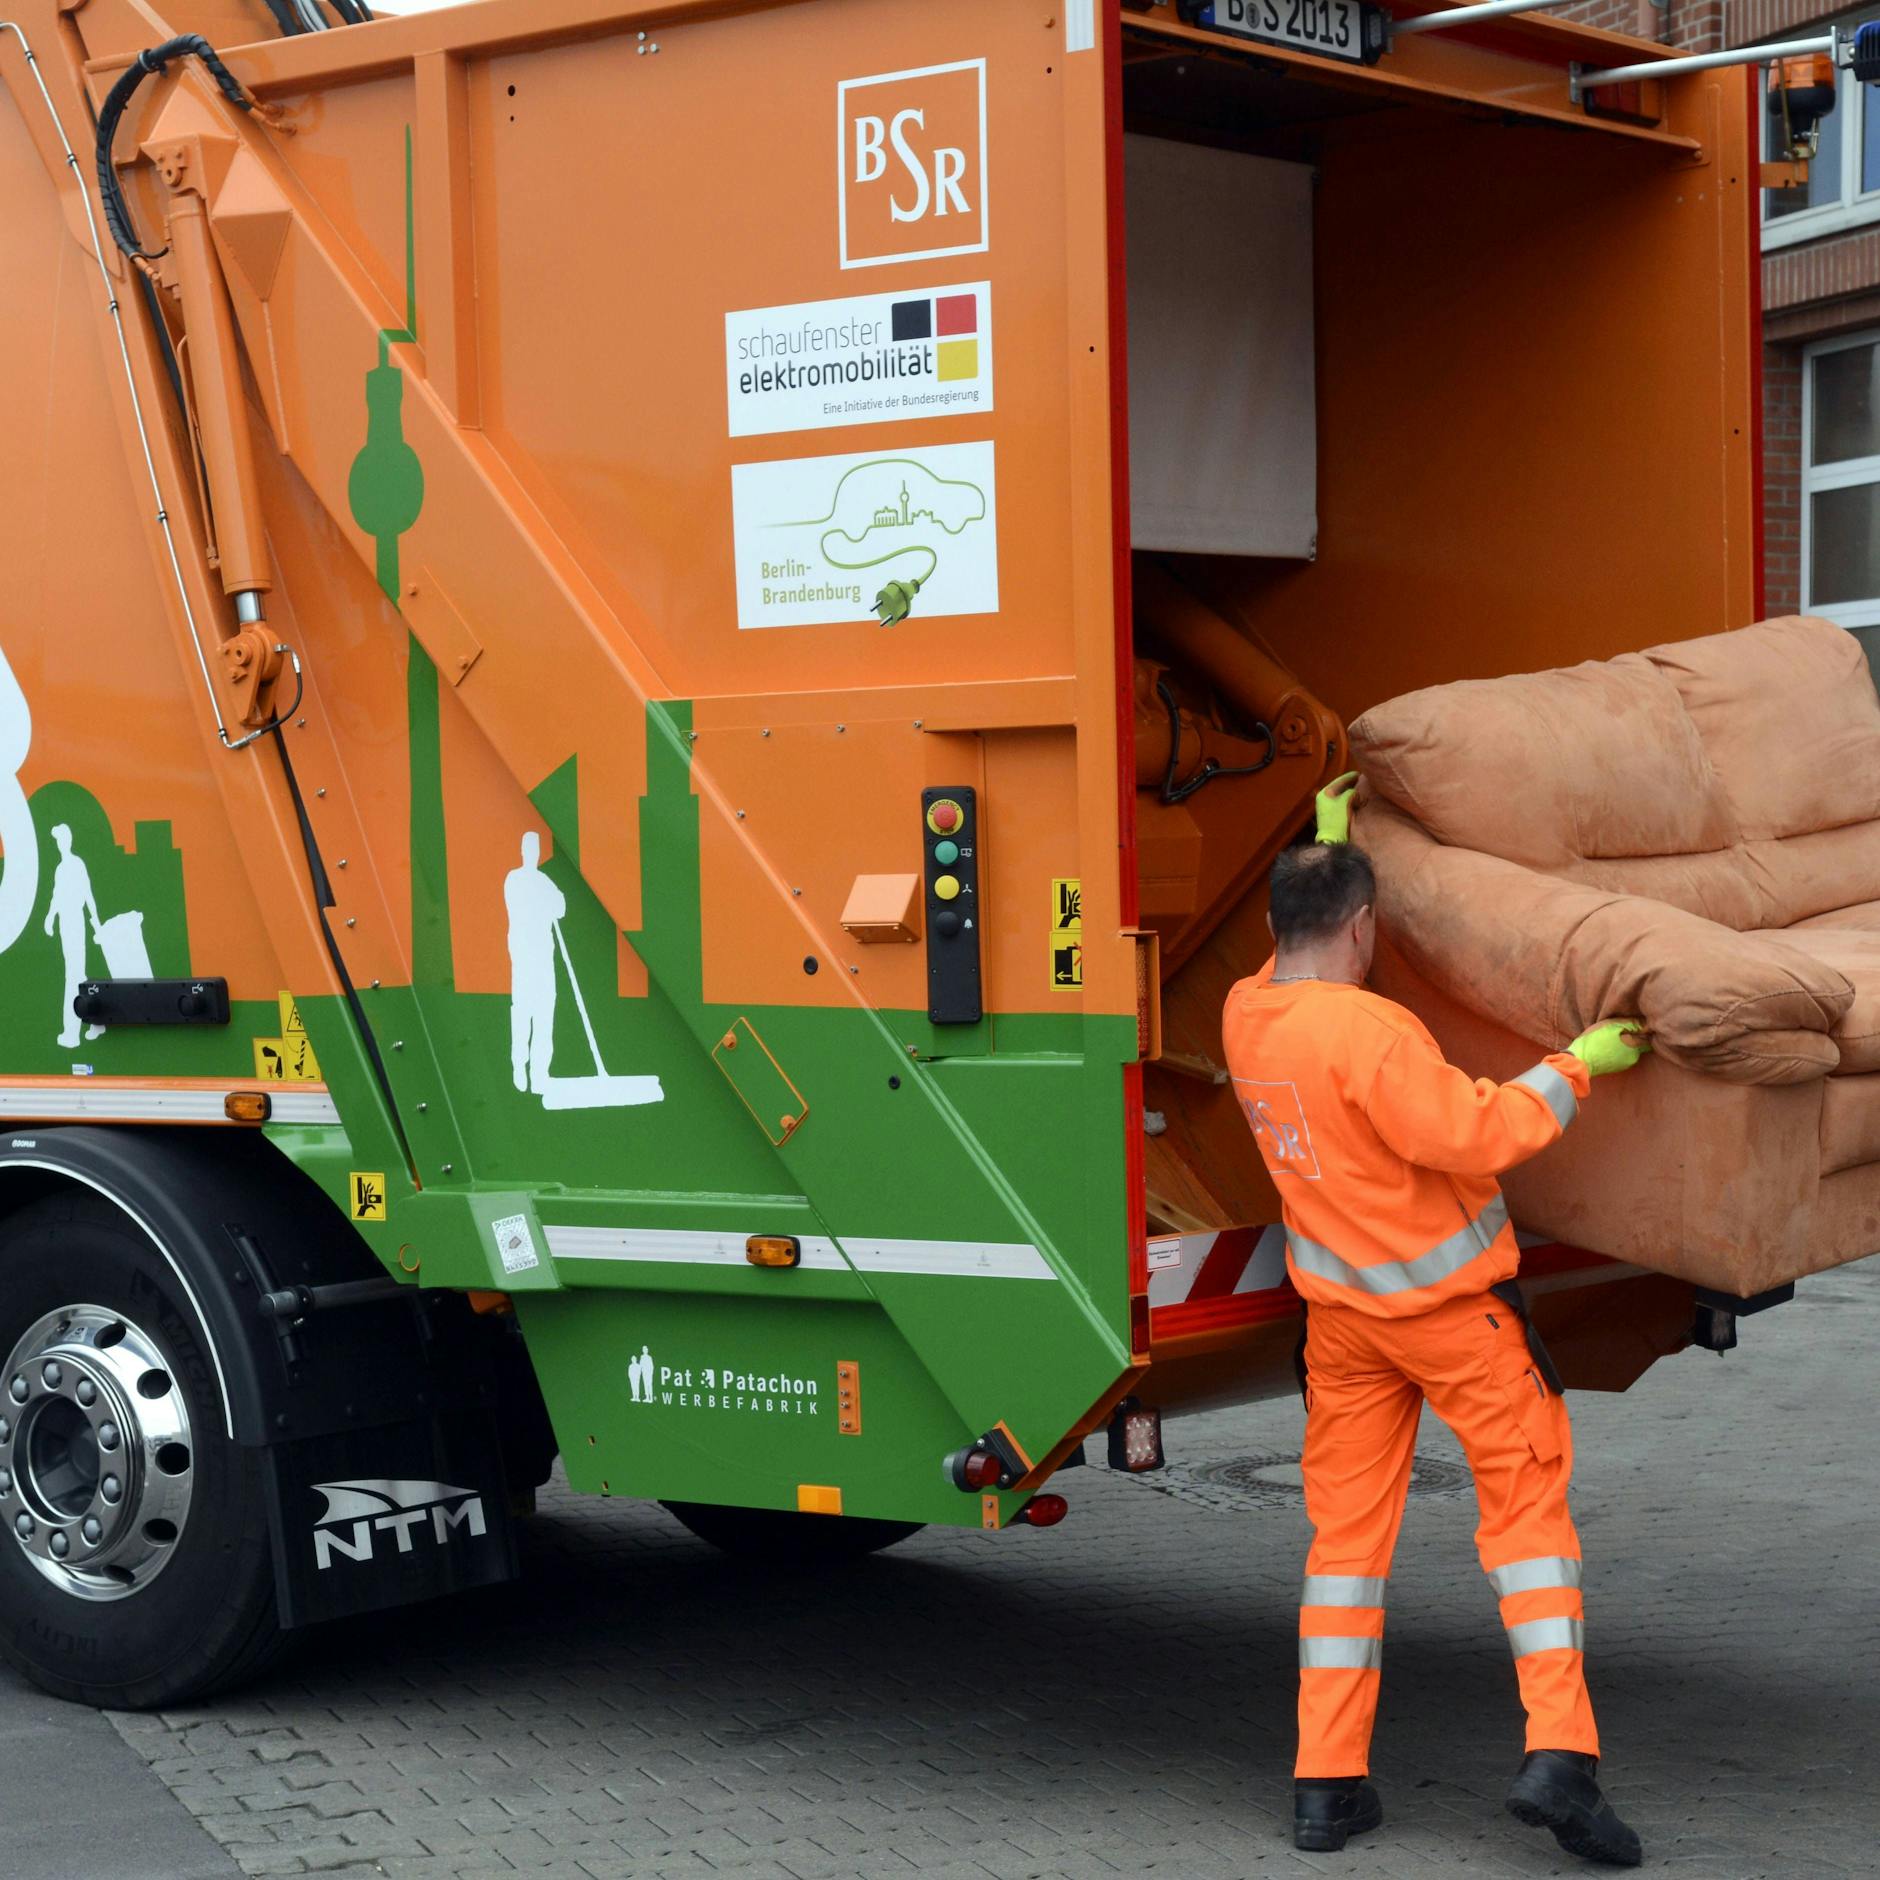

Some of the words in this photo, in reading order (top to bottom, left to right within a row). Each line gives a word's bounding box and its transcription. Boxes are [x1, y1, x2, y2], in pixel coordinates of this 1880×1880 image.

[1286, 0, 1350, 48] 2013
[854, 108, 972, 223] BSR
[738, 316, 882, 360] schaufenster
[739, 344, 933, 394] elektromobilität
[823, 402, 842, 415] Eine
[844, 397, 883, 413] Initiative
[885, 395, 900, 408] der
[902, 389, 979, 407] Bundesregierung
[761, 558, 812, 579] Berlin-
[762, 582, 862, 605] Brandenburg
[660, 1366, 692, 1387] Pat
[722, 1370, 818, 1395] Patachon
[662, 1392, 818, 1415] WERBEFABRIK
[313, 1497, 487, 1570] NTM
